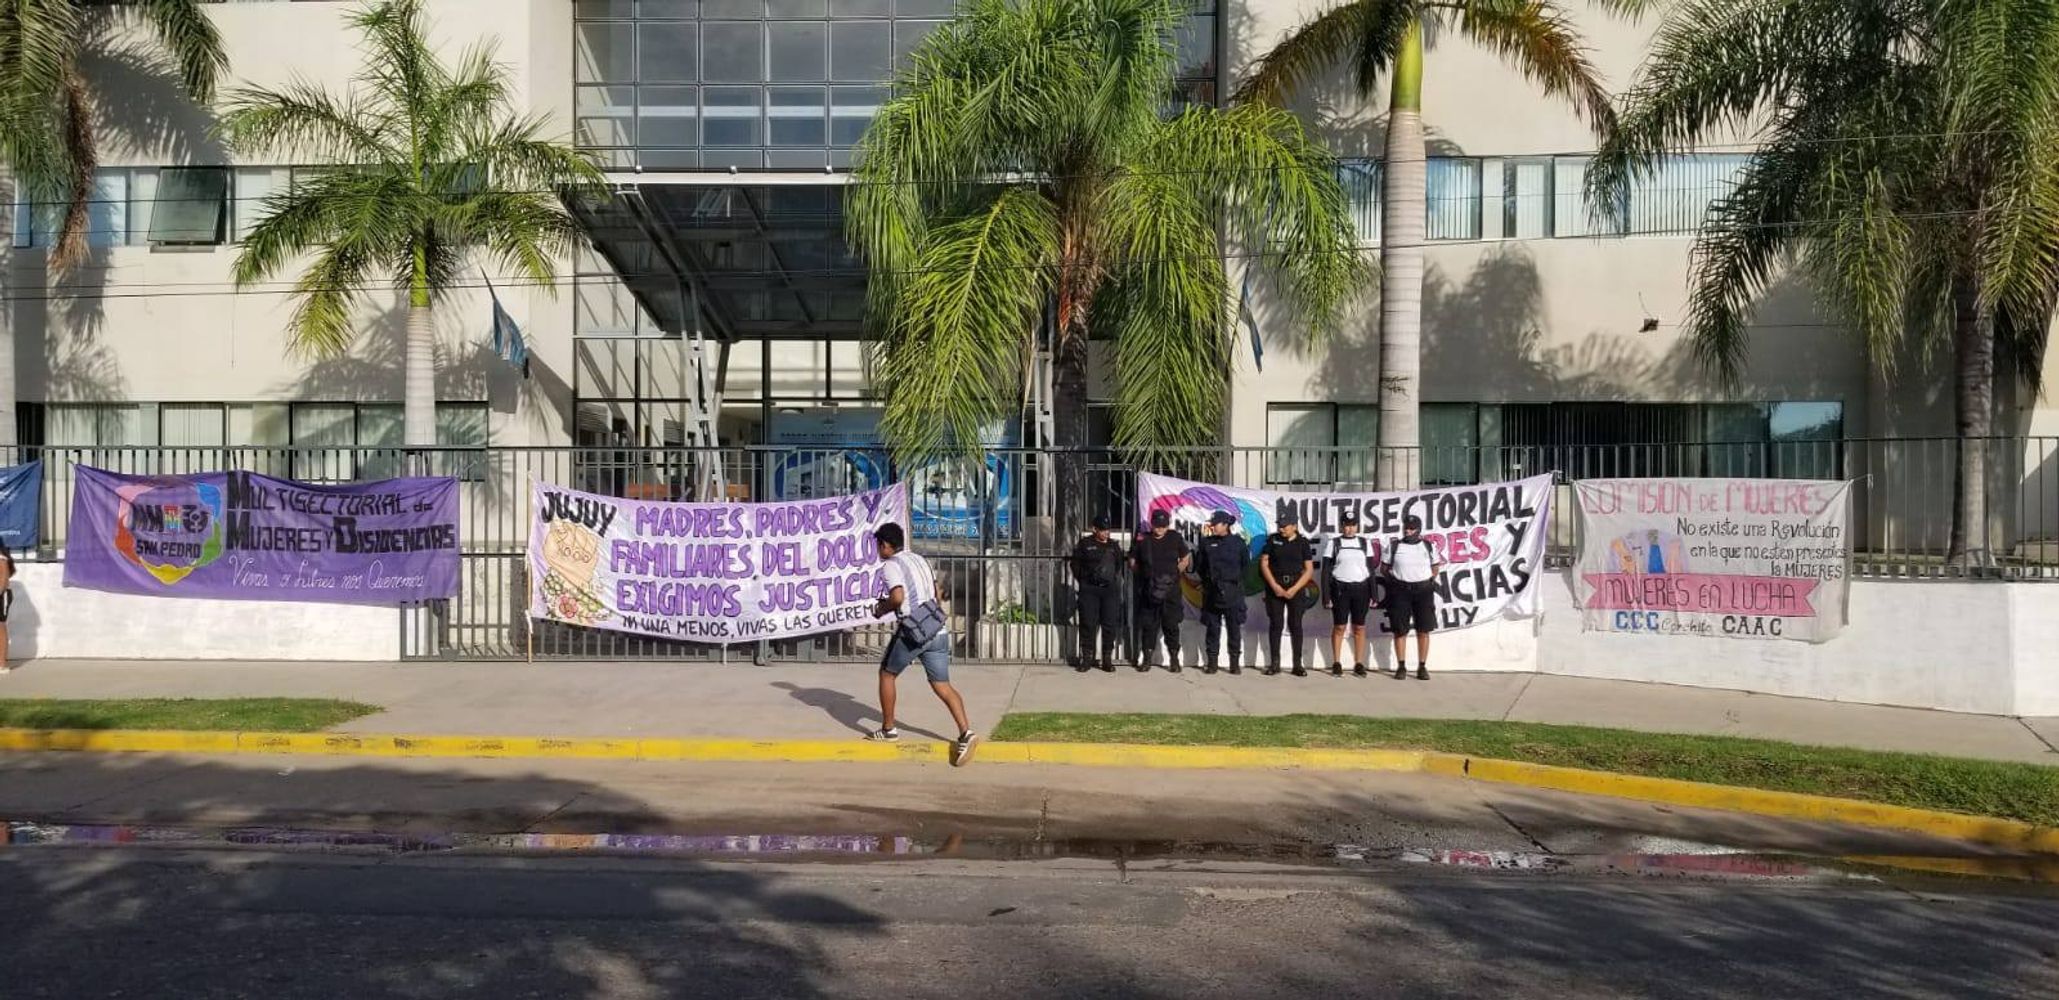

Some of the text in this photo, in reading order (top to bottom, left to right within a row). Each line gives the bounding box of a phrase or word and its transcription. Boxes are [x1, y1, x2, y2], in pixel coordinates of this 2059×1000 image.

[541, 491, 617, 537] JUJUY
[1699, 494, 1719, 512] DE
[1725, 481, 1829, 515] MUJERES
[635, 493, 882, 539] MADRES, PADRES Y
[1676, 517, 1840, 541] No existe una Revolución
[161, 540, 201, 559] PEDRO
[762, 542, 810, 577] DEL
[817, 530, 878, 572] DOLO
[1505, 521, 1528, 556] Y
[1690, 545, 1706, 557] en
[1708, 541, 1718, 557] la
[1720, 546, 1741, 566] que
[1744, 546, 1760, 559] no
[229, 554, 269, 587] Vivas
[1771, 560, 1843, 581] la MUJERES
[617, 568, 890, 617] EXIGIMOS JUSTICIA
[1604, 577, 1690, 608] MUJERES
[1731, 582, 1796, 611] LUCHA
[641, 617, 671, 634] UNA
[736, 618, 778, 636] VIVAS
[784, 615, 812, 631] LAS
[817, 602, 879, 627] QUEREM
[1722, 615, 1783, 636] CAAC
